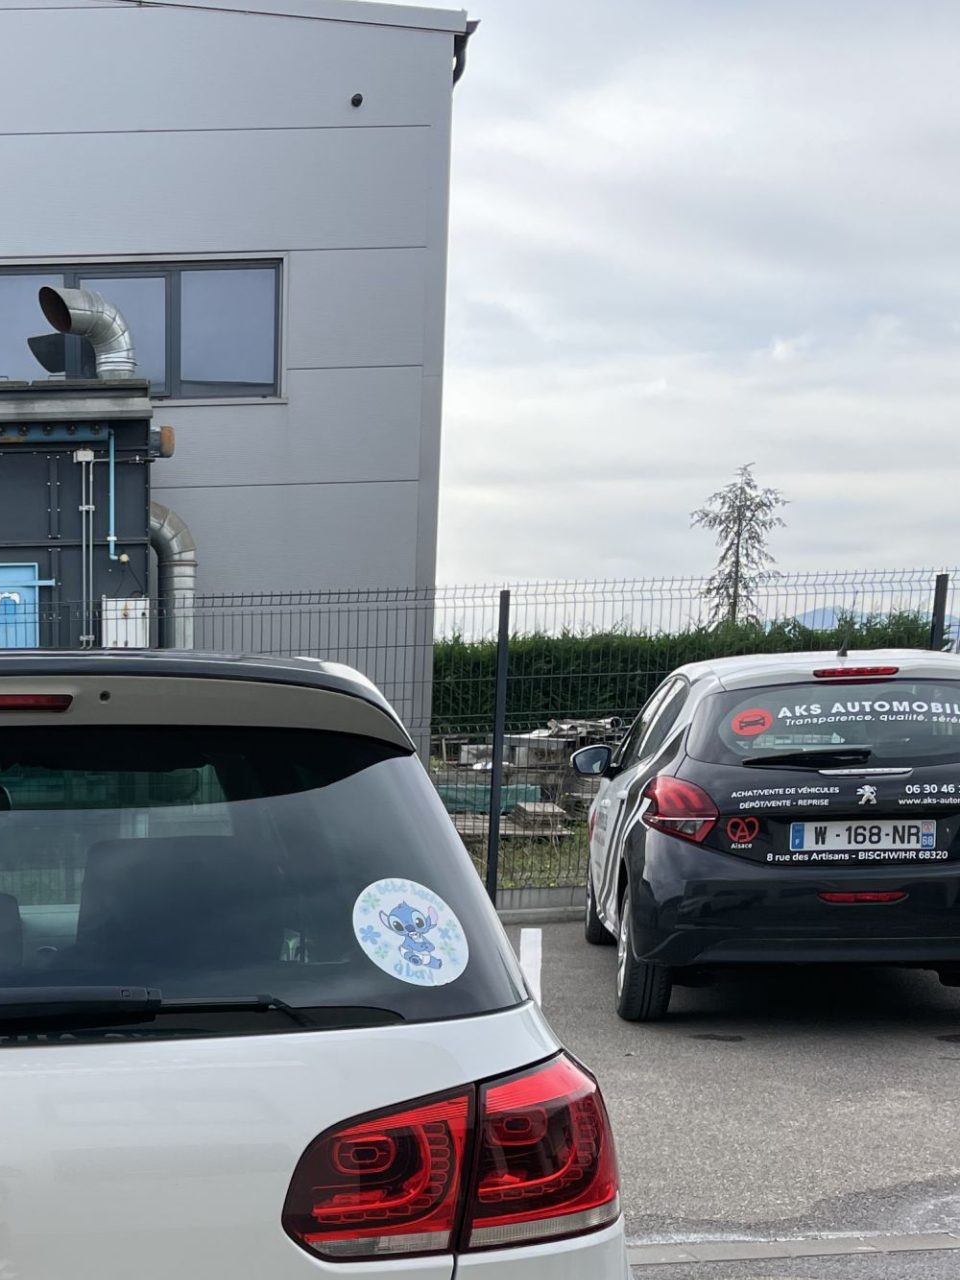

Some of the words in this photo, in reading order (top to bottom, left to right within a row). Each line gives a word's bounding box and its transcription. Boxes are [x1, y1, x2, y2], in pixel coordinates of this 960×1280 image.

[777, 703, 822, 719] AKS
[932, 714, 960, 725] séré
[731, 787, 784, 798] ACHAT/VENTE
[798, 786, 840, 794] VÉHICULES
[905, 784, 921, 794] 06
[923, 784, 938, 793] 30
[940, 784, 955, 793] 46
[739, 799, 792, 809] DÉPÔT/VENTE
[798, 798, 830, 806] REPRISE
[766, 853, 774, 862] 8
[792, 853, 809, 861] des
[810, 852, 850, 861] Artisans
[858, 852, 917, 860] BISCHWIHR
[918, 850, 949, 860] 68320
